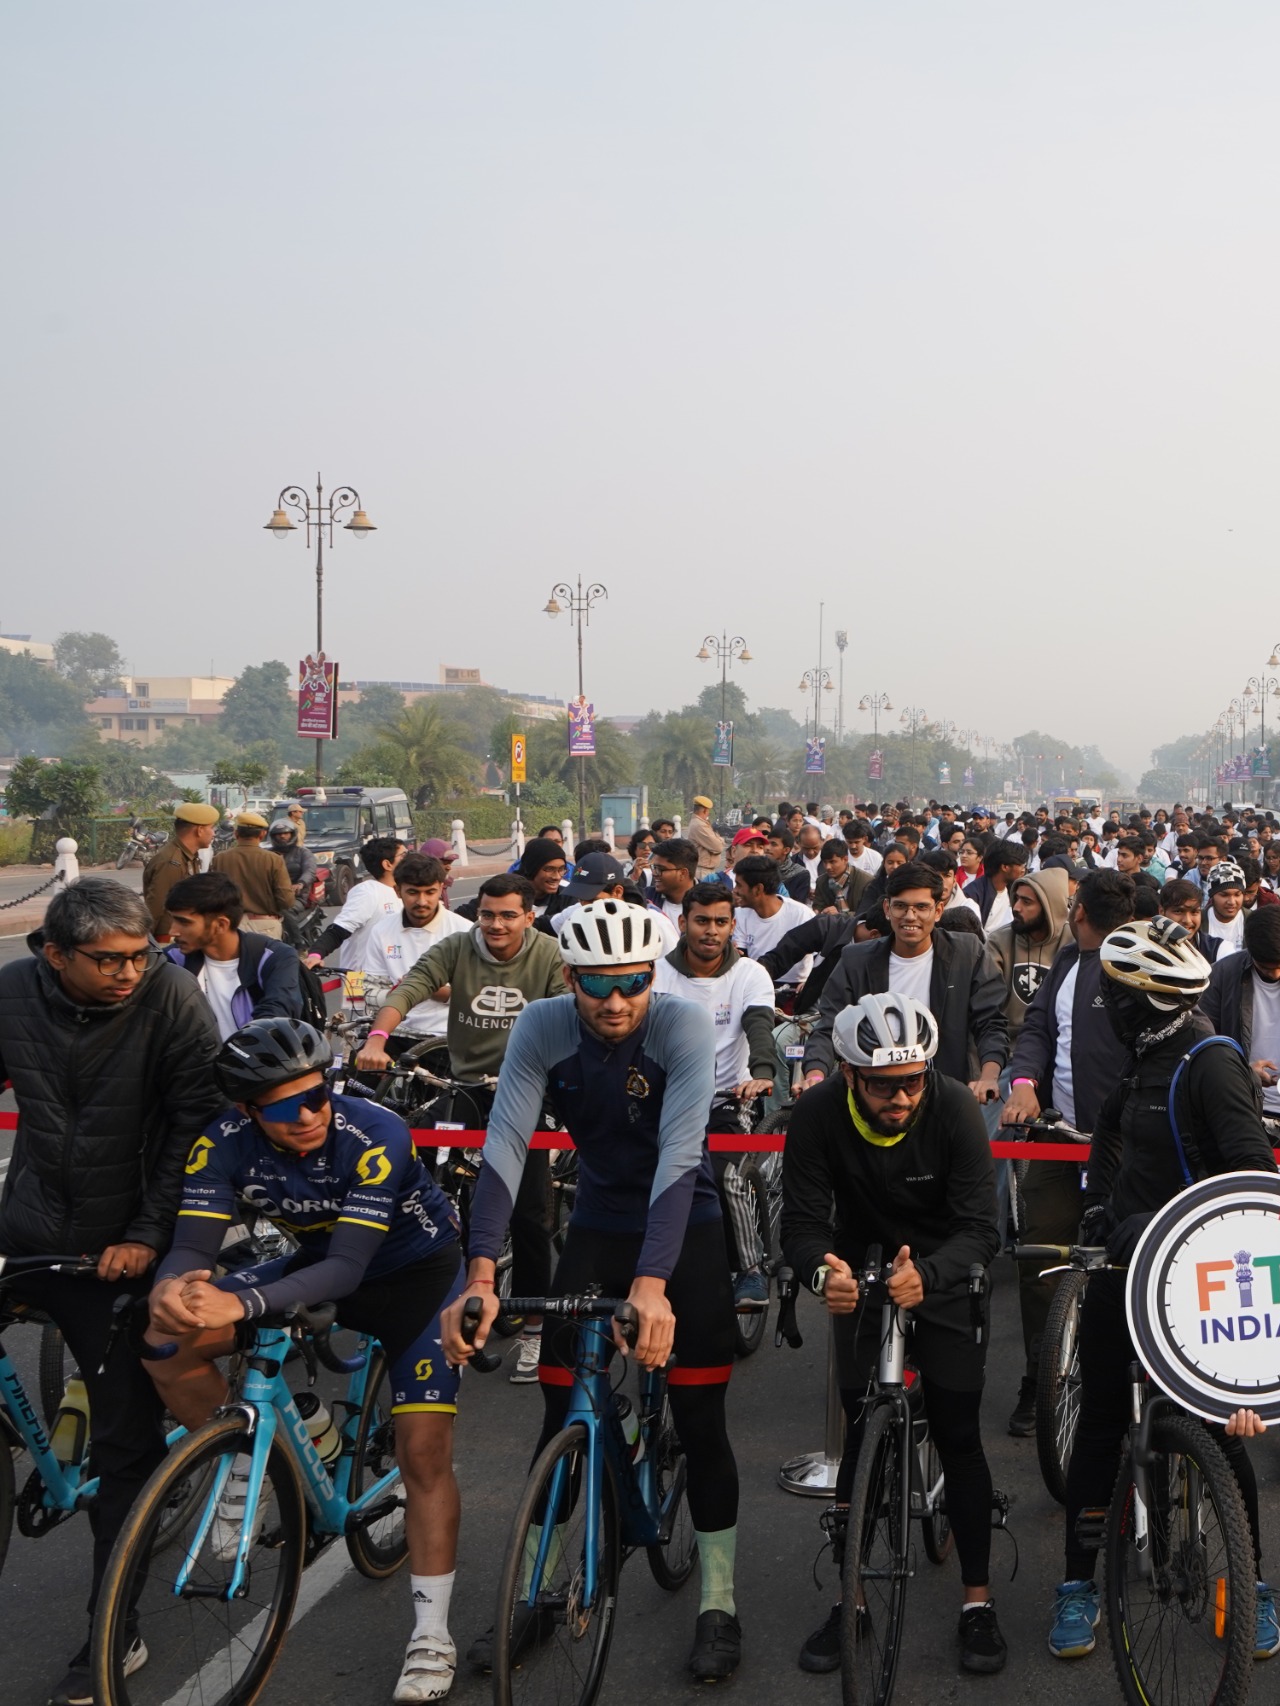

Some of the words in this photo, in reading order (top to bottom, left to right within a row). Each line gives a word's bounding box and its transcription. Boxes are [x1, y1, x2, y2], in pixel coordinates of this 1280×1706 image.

[461, 670, 479, 679] LIC
[387, 945, 402, 954] FIT
[458, 1012, 513, 1030] BALENCI
[888, 1048, 917, 1062] 1374
[346, 1124, 373, 1147] ORICA
[282, 1198, 342, 1214] ORIC
[413, 1203, 439, 1239] ORICA
[283, 1399, 335, 1500] FOCUS
